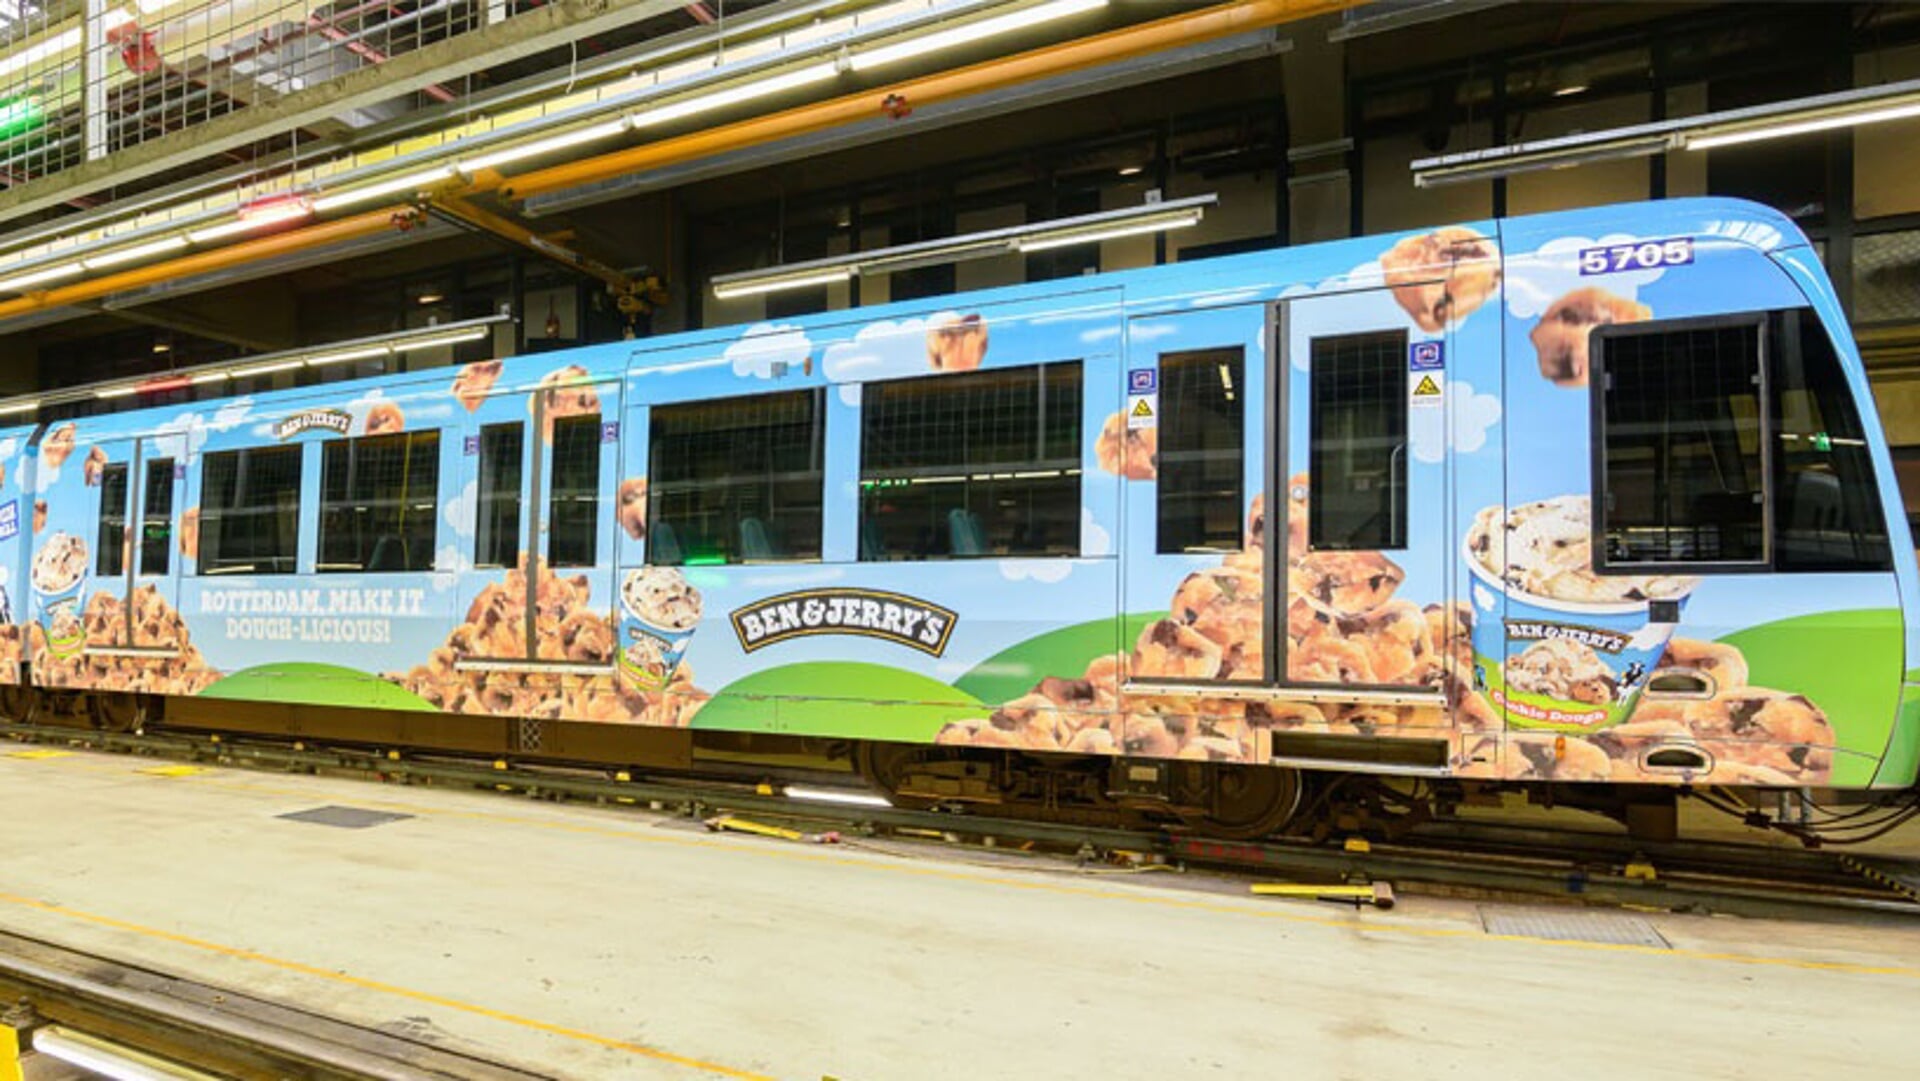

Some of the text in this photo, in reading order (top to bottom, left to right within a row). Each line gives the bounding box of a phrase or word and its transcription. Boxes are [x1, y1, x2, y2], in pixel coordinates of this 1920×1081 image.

[1583, 240, 1690, 273] 5705
[328, 589, 393, 614] MAKE
[397, 588, 424, 615] IT
[225, 617, 392, 643] DOUGH-LICIOUS!
[1549, 710, 1605, 725] Dough
